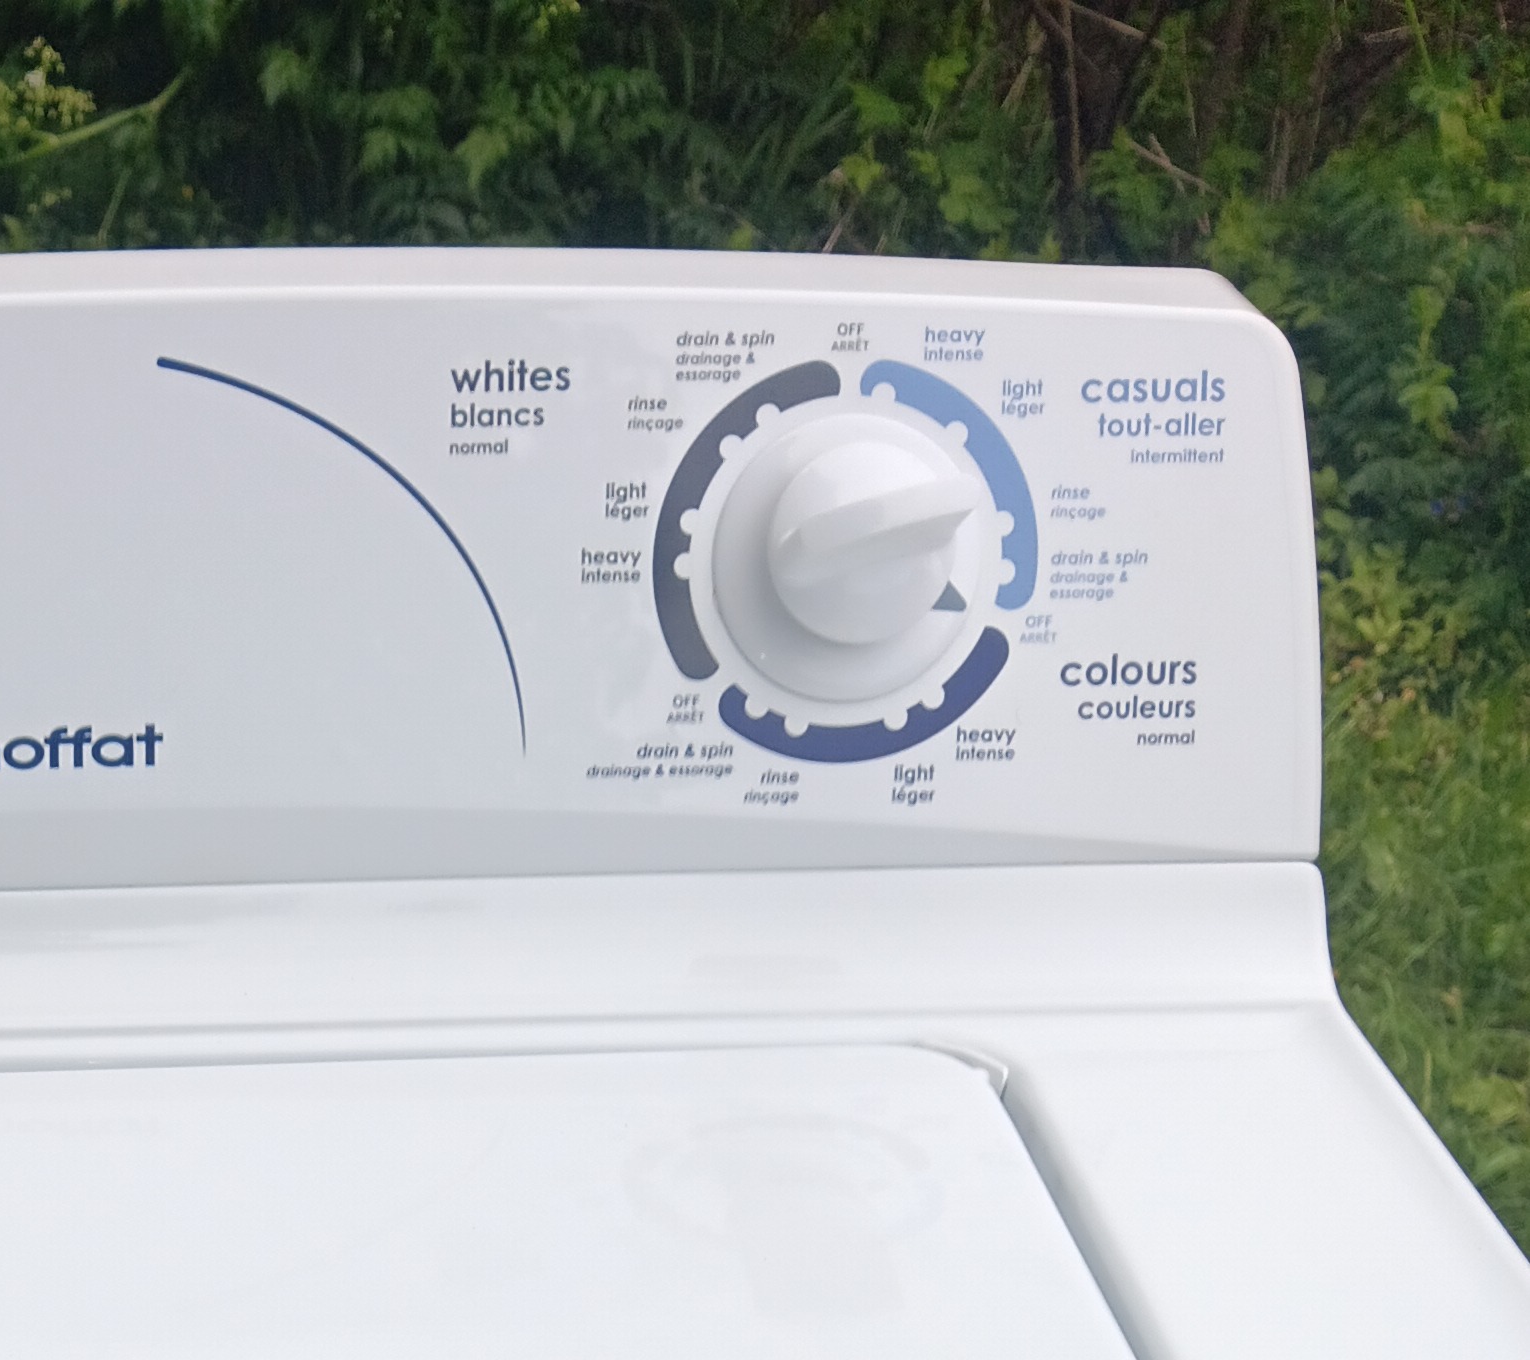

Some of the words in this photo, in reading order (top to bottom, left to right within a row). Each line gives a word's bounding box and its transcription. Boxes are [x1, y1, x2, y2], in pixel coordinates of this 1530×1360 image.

[837, 322, 865, 336] OFF
[924, 326, 985, 346] heavy
[676, 330, 719, 347] drain
[725, 331, 737, 346] &
[741, 330, 775, 349] spin
[831, 336, 870, 351] ARRÊT
[676, 351, 742, 367] drainage
[745, 351, 755, 364] &
[924, 346, 984, 361] intense
[451, 360, 571, 393] whites
[676, 368, 741, 383] essorage
[1002, 379, 1043, 398] light
[1081, 369, 1226, 403] casuals
[627, 395, 668, 411] rinse
[1001, 397, 1045, 418] léger
[450, 403, 545, 428] blancs
[627, 415, 684, 432] rinçage
[1098, 412, 1226, 437] tout-aller
[449, 439, 509, 455] normal
[1131, 448, 1224, 463] intermittent
[606, 482, 646, 504] light
[1051, 484, 1090, 500] rinse
[605, 500, 649, 521] léger
[1050, 504, 1106, 521] rinçage
[581, 548, 641, 567] heavy
[1050, 549, 1094, 565] drain
[1098, 551, 1110, 565] &
[1115, 549, 1149, 568] spin
[581, 567, 641, 584] intense
[1050, 570, 1115, 585] drainage
[1119, 570, 1129, 583] &
[1050, 587, 1115, 601] essorage
[1025, 615, 1052, 628] OFF
[1060, 653, 1198, 686] colours
[672, 693, 701, 709] OFF
[1078, 695, 1196, 720] couleurs
[956, 725, 1016, 745] heavy
[1136, 730, 1196, 746] normal
[636, 742, 679, 760] drain
[684, 742, 695, 759] &
[700, 741, 734, 761] spin
[955, 746, 1016, 762] intense
[586, 763, 650, 781] drainage
[655, 763, 665, 777] &
[669, 762, 734, 779] essorage
[760, 768, 800, 786] rinse
[894, 764, 935, 786] light
[743, 788, 799, 806] rinçage
[892, 784, 935, 807] léger
